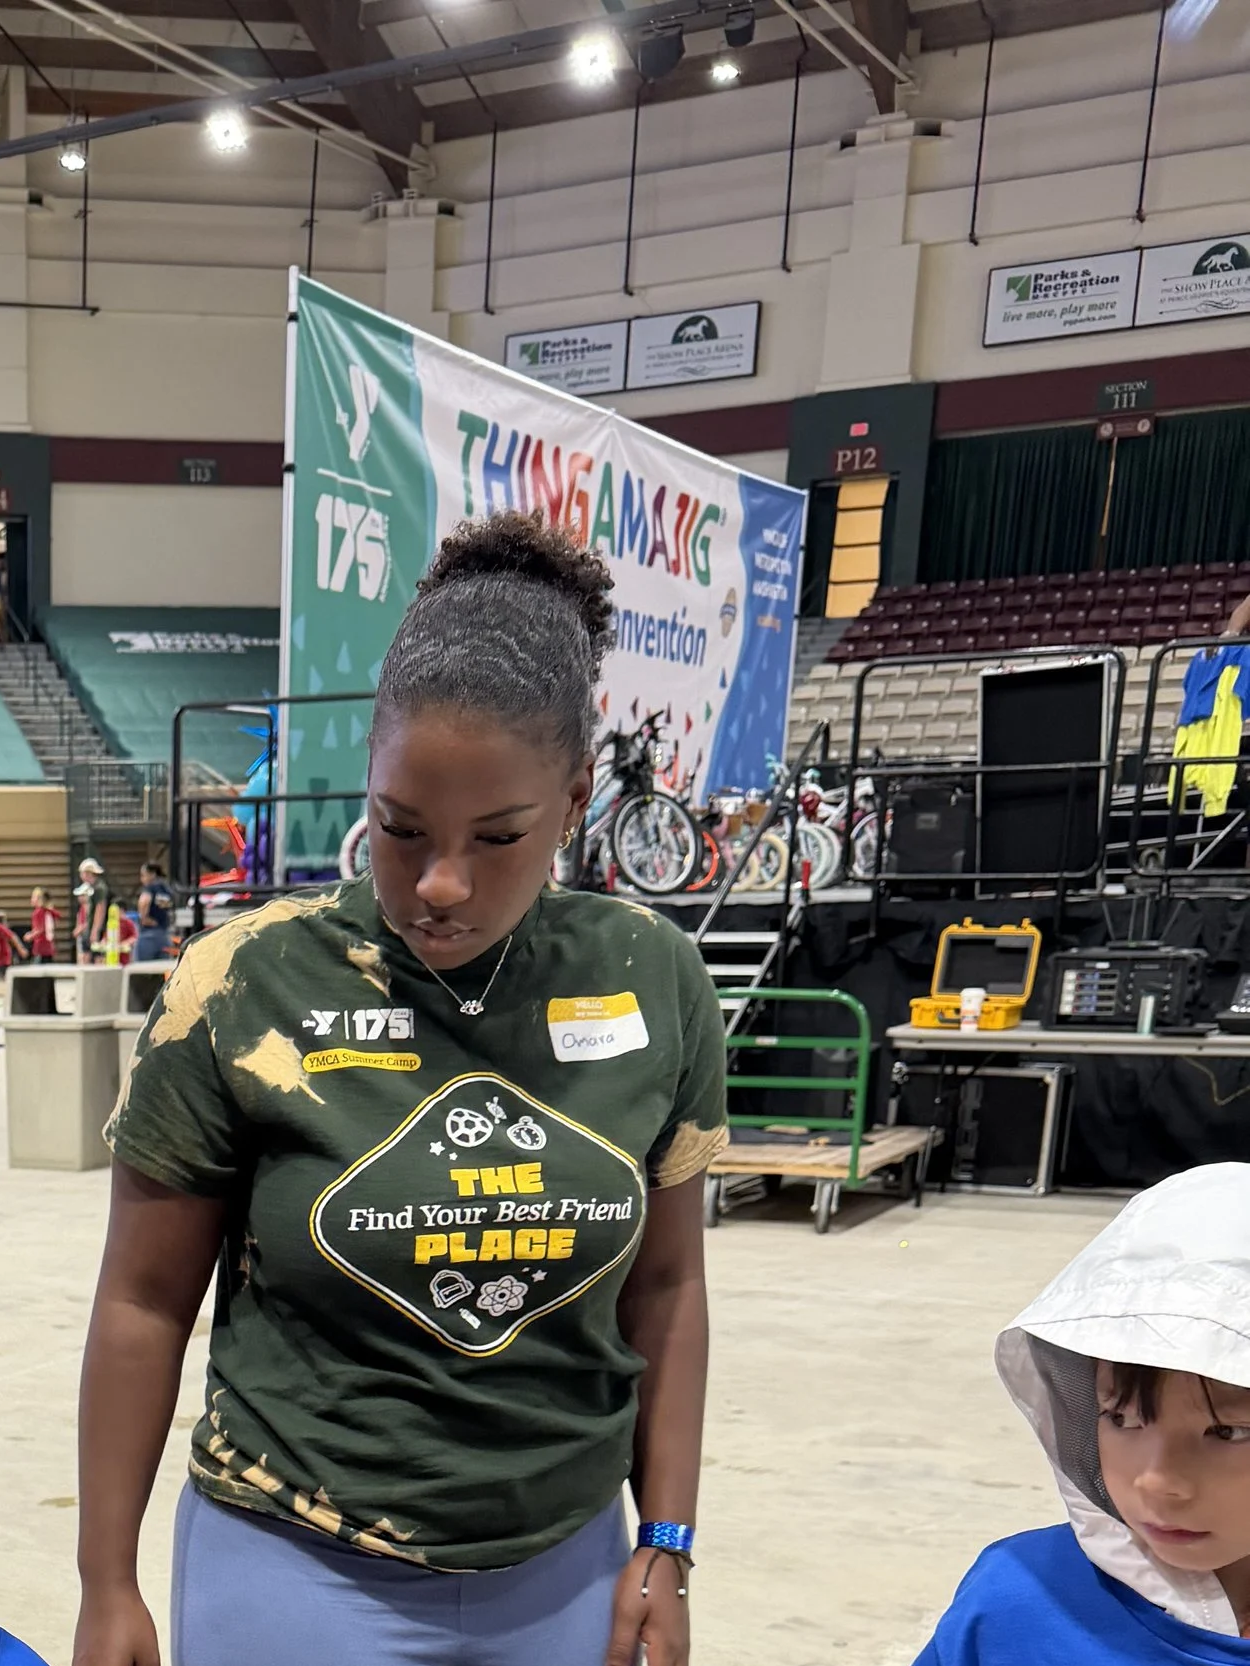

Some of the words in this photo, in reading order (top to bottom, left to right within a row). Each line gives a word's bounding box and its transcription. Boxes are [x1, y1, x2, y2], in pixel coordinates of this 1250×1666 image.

[1033, 270, 1079, 282] Parks
[1082, 269, 1091, 277] &
[1033, 274, 1120, 294] Recreation
[1002, 311, 1024, 323] live
[1026, 309, 1057, 319] more,
[1060, 303, 1086, 318] play
[1087, 301, 1116, 311] more
[541, 342, 612, 358] Recreation
[1105, 381, 1147, 393] SECTION
[1112, 393, 1136, 409] 111
[836, 448, 877, 471] P12
[458, 410, 720, 586] THINGAMAJIG
[315, 493, 385, 600] 175
[610, 606, 707, 666] nvention
[352, 1008, 410, 1040] 175
[309, 1054, 340, 1067] YMCA
[342, 1053, 384, 1065] Summer
[387, 1057, 417, 1069] Camp
[450, 1162, 544, 1197] THE
[348, 1206, 414, 1232] Find
[419, 1202, 488, 1227] Your
[495, 1200, 553, 1224] Best
[556, 1196, 633, 1222] Friend
[414, 1228, 577, 1265] PLACE
